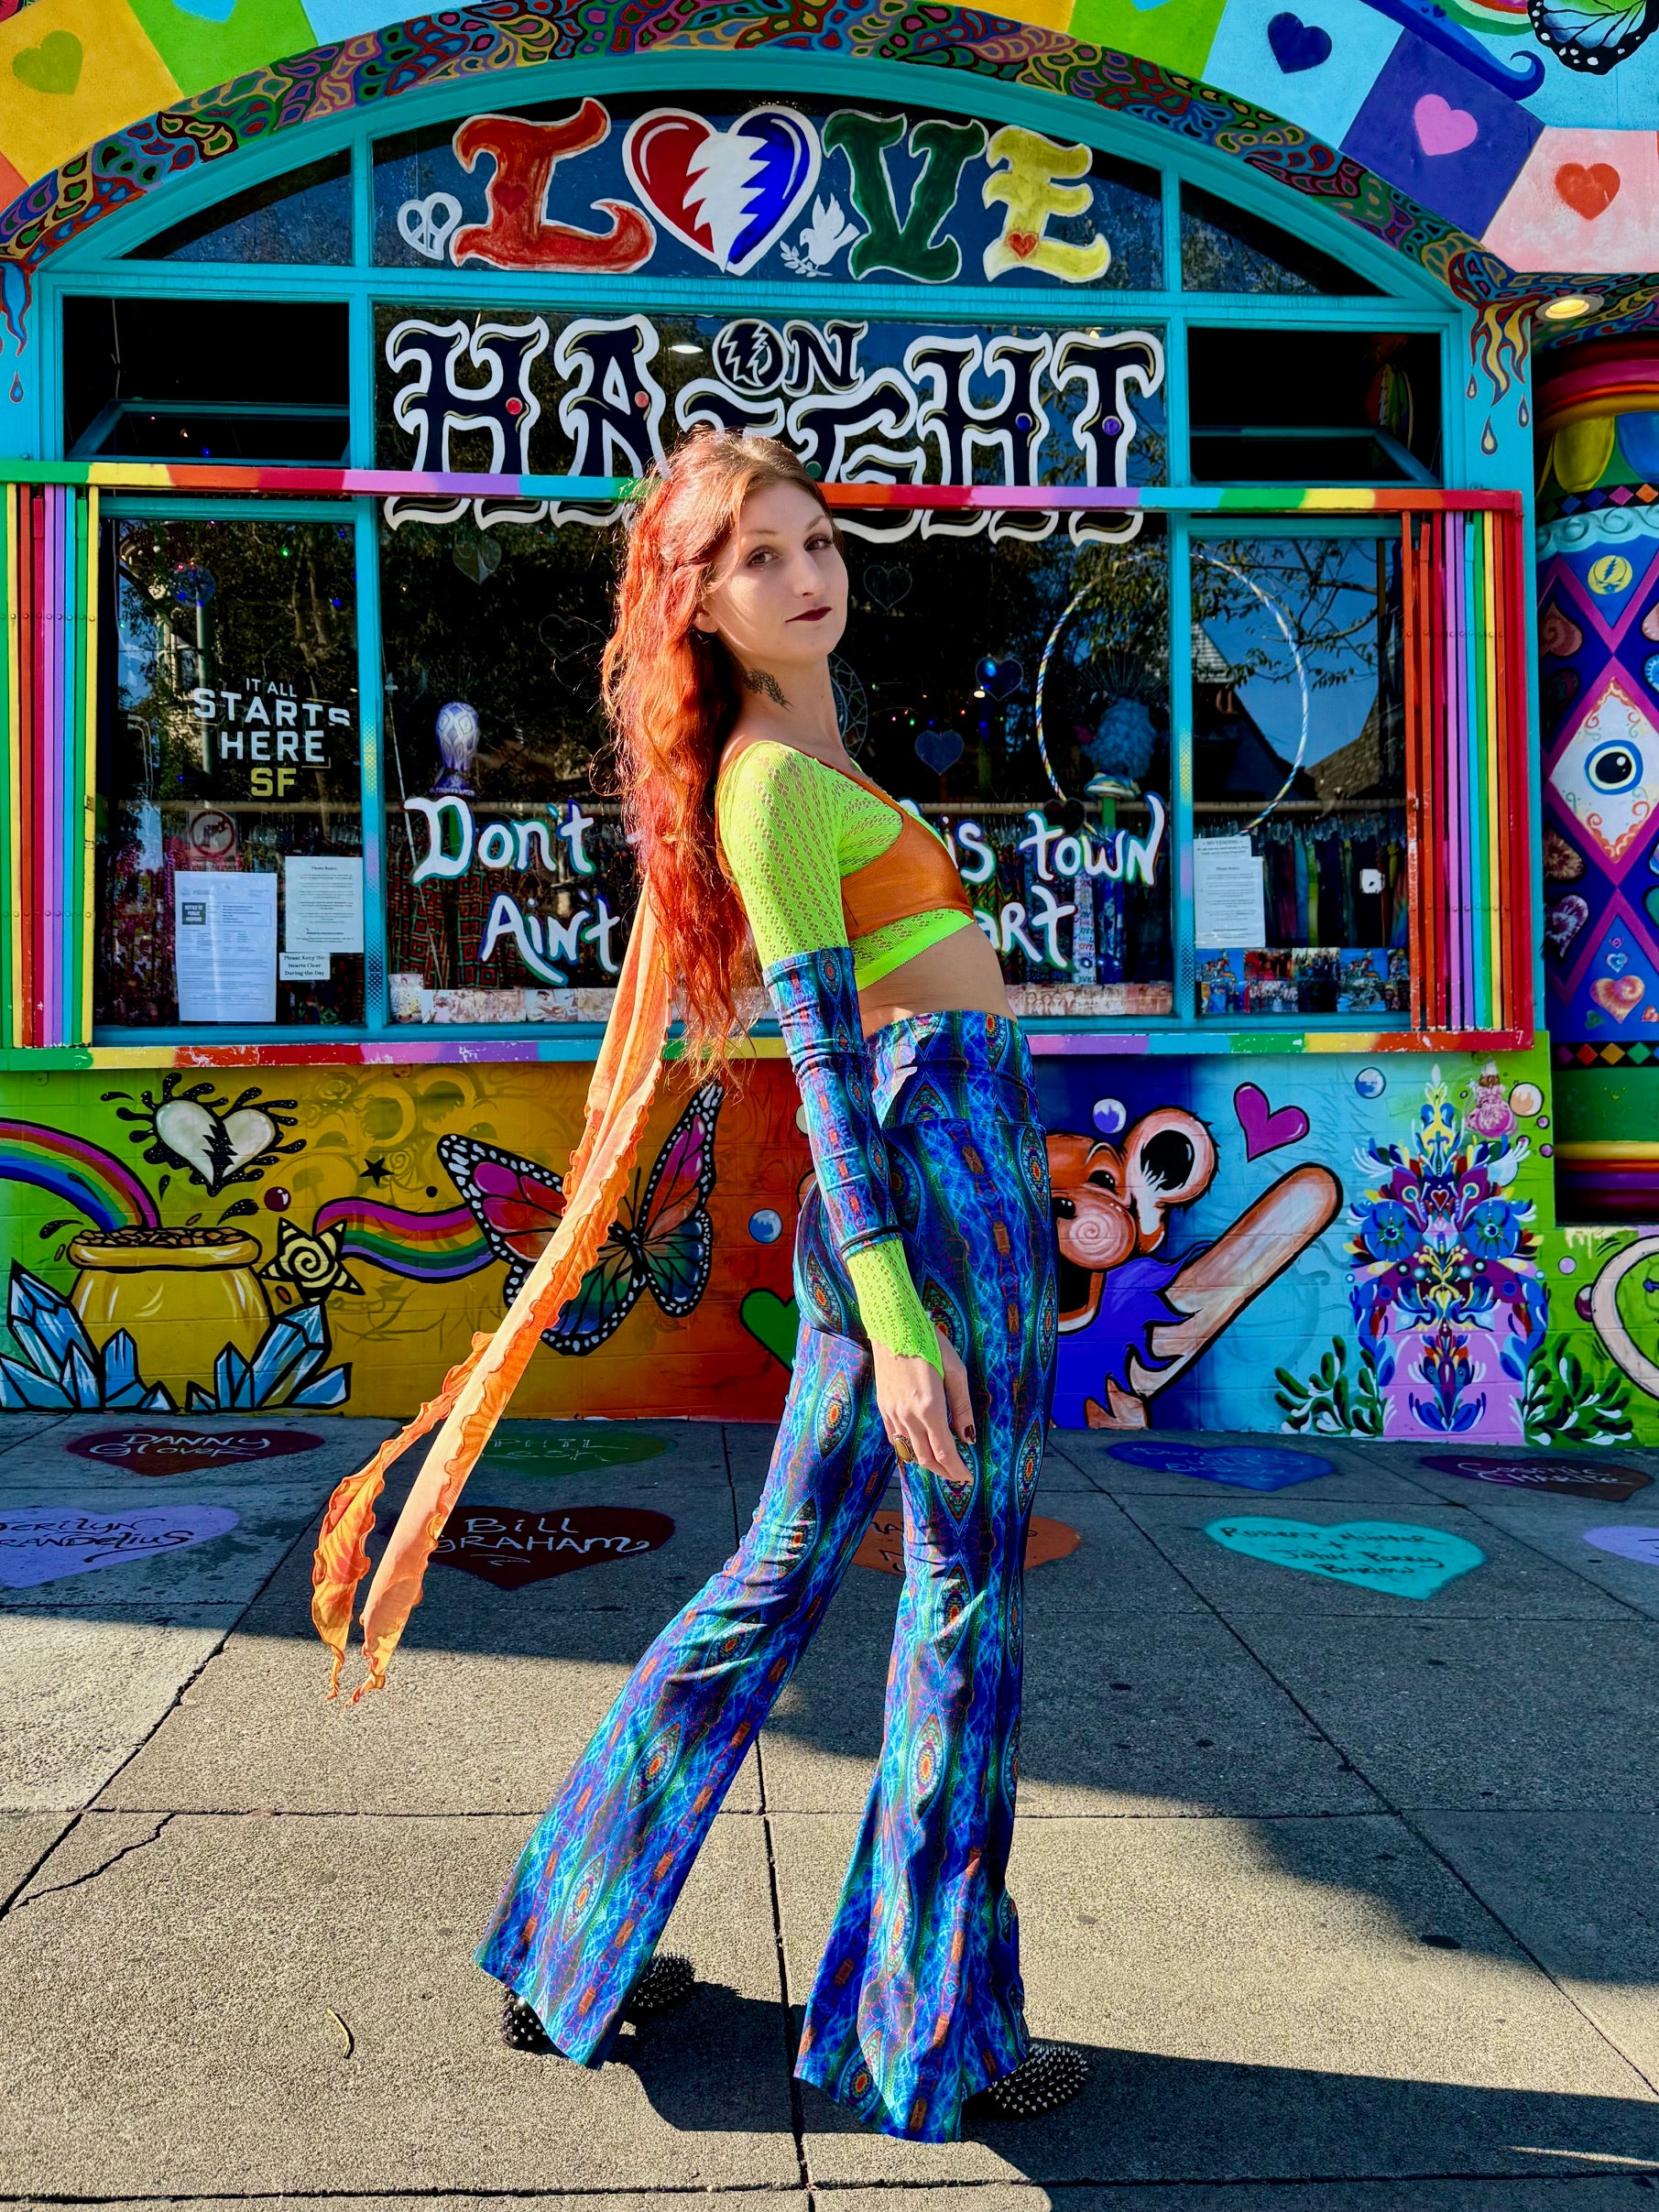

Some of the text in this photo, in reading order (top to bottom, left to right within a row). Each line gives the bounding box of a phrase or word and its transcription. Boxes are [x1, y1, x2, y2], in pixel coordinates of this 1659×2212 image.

[246, 677, 298, 698] IT ALL
[192, 687, 351, 727] STARTS
[221, 730, 325, 762] HERE
[250, 767, 297, 797] SF
[403, 794, 596, 887] Don't
